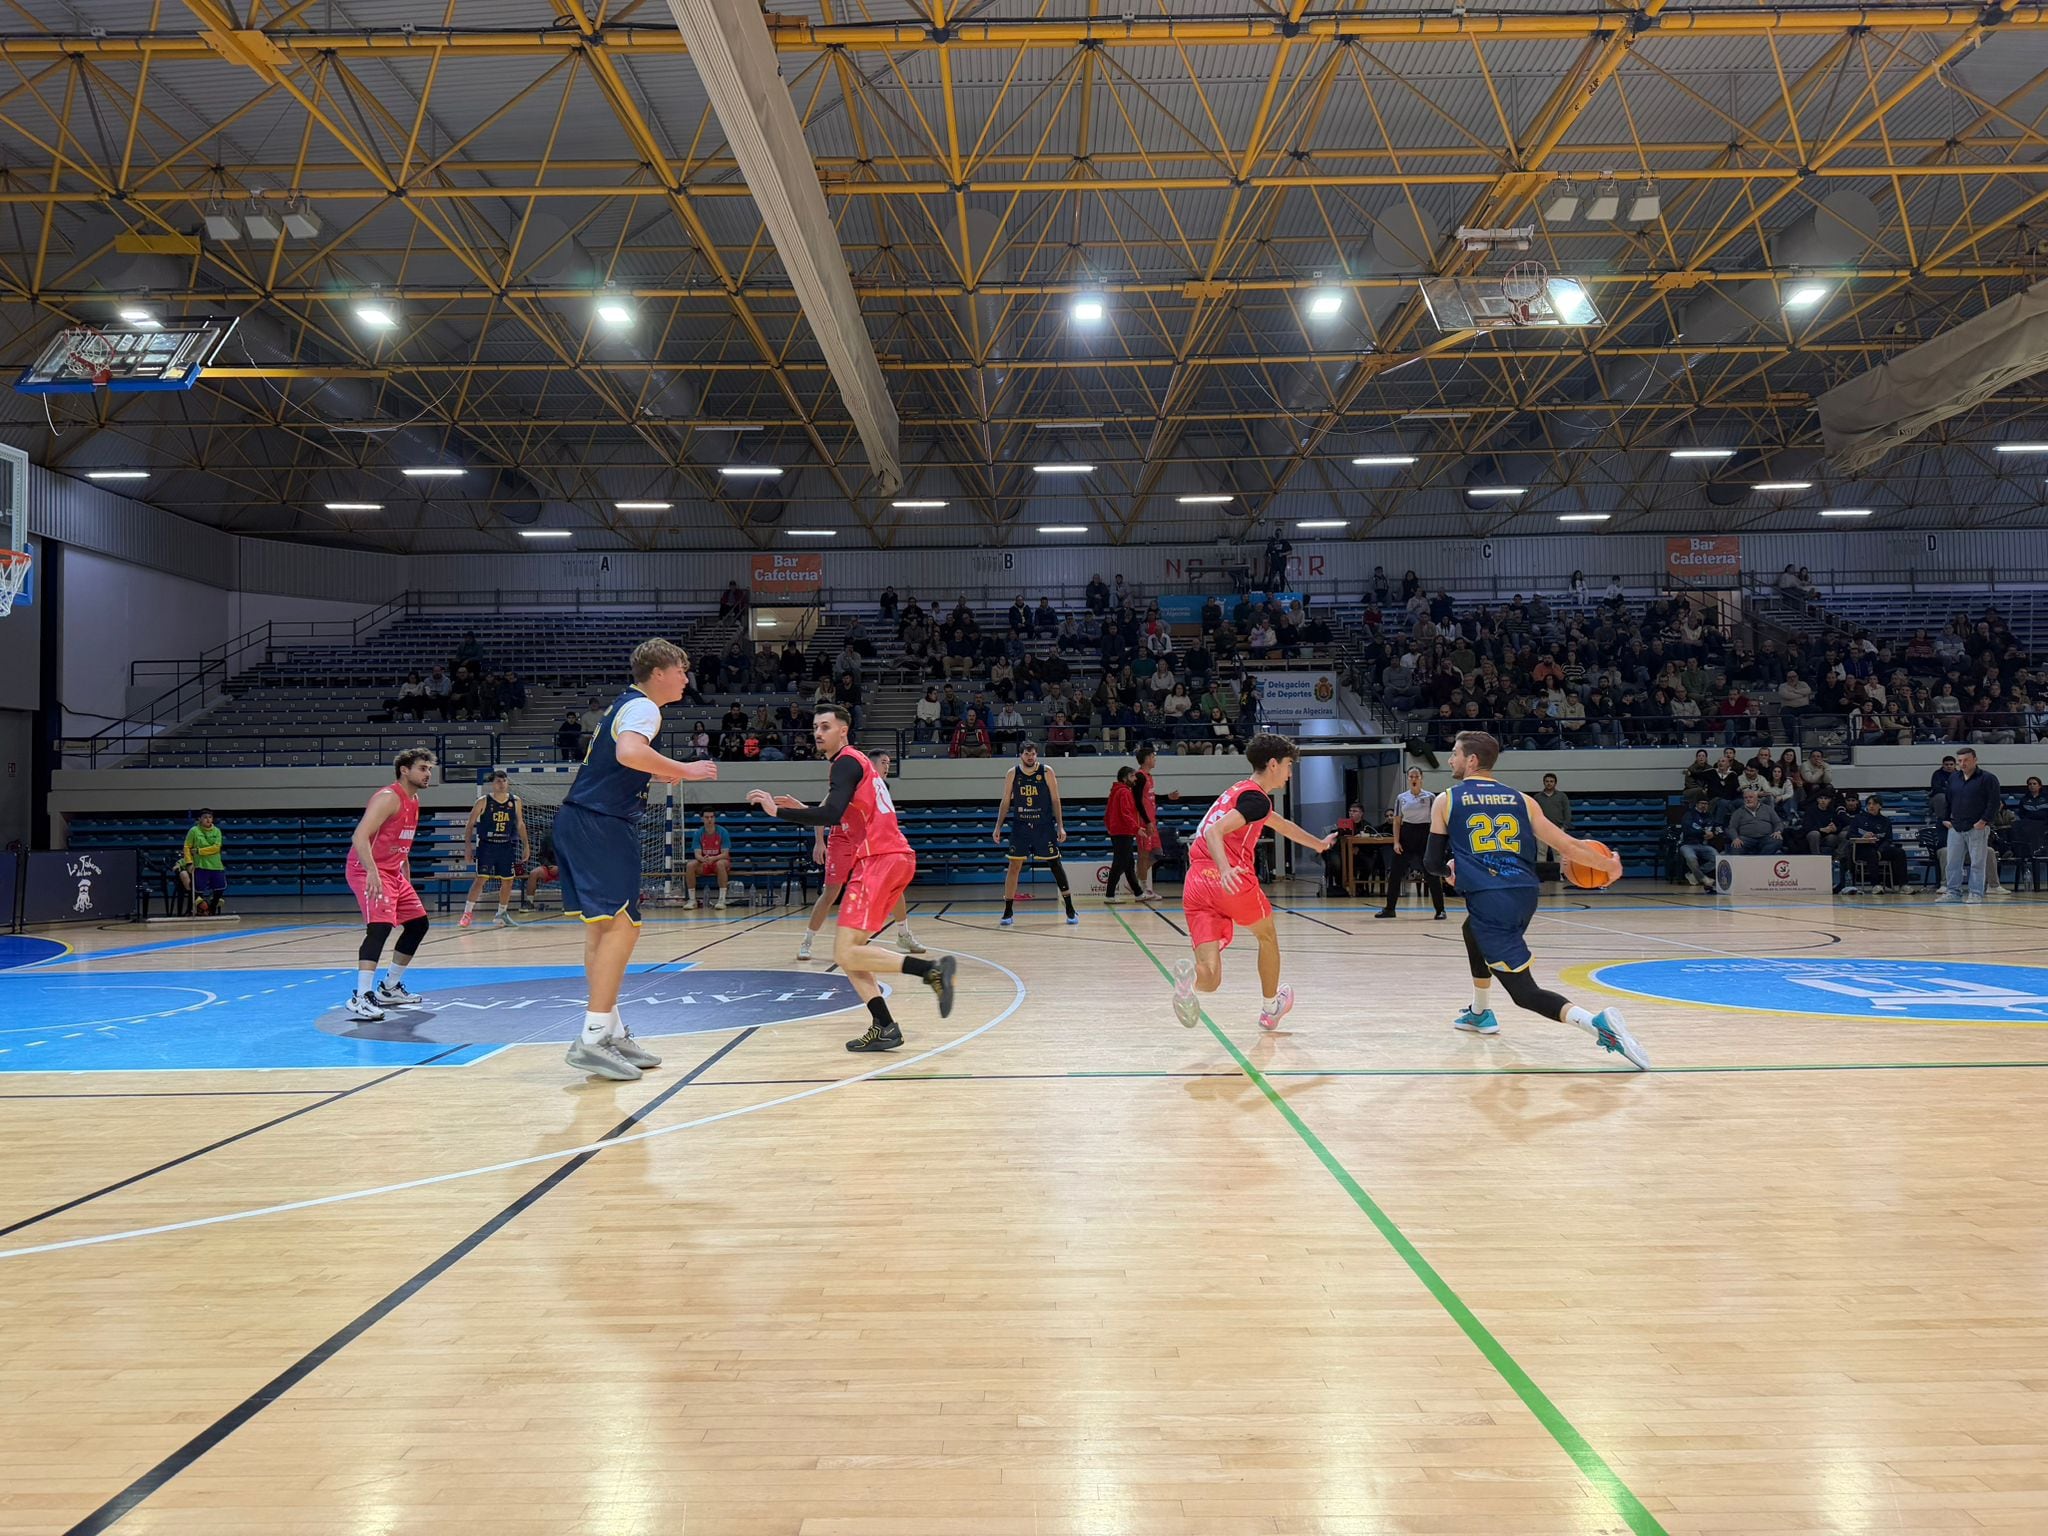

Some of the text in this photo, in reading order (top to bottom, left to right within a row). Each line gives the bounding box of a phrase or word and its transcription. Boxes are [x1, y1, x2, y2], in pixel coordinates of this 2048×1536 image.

[1690, 539, 1714, 550] Bar
[1928, 535, 1936, 550] D
[1483, 544, 1491, 558] C
[601, 556, 609, 571] A
[774, 555, 798, 567] Bar
[1005, 553, 1013, 568] B
[1268, 680, 1310, 689] Delegación
[1278, 691, 1312, 699] Deportes
[1303, 708, 1333, 716] Algeciras
[1020, 785, 1038, 797] CBA
[1026, 797, 1033, 807] 9
[1461, 792, 1518, 806] ÁLVAREZ
[495, 822, 506, 832] 15
[1466, 813, 1520, 854] 22
